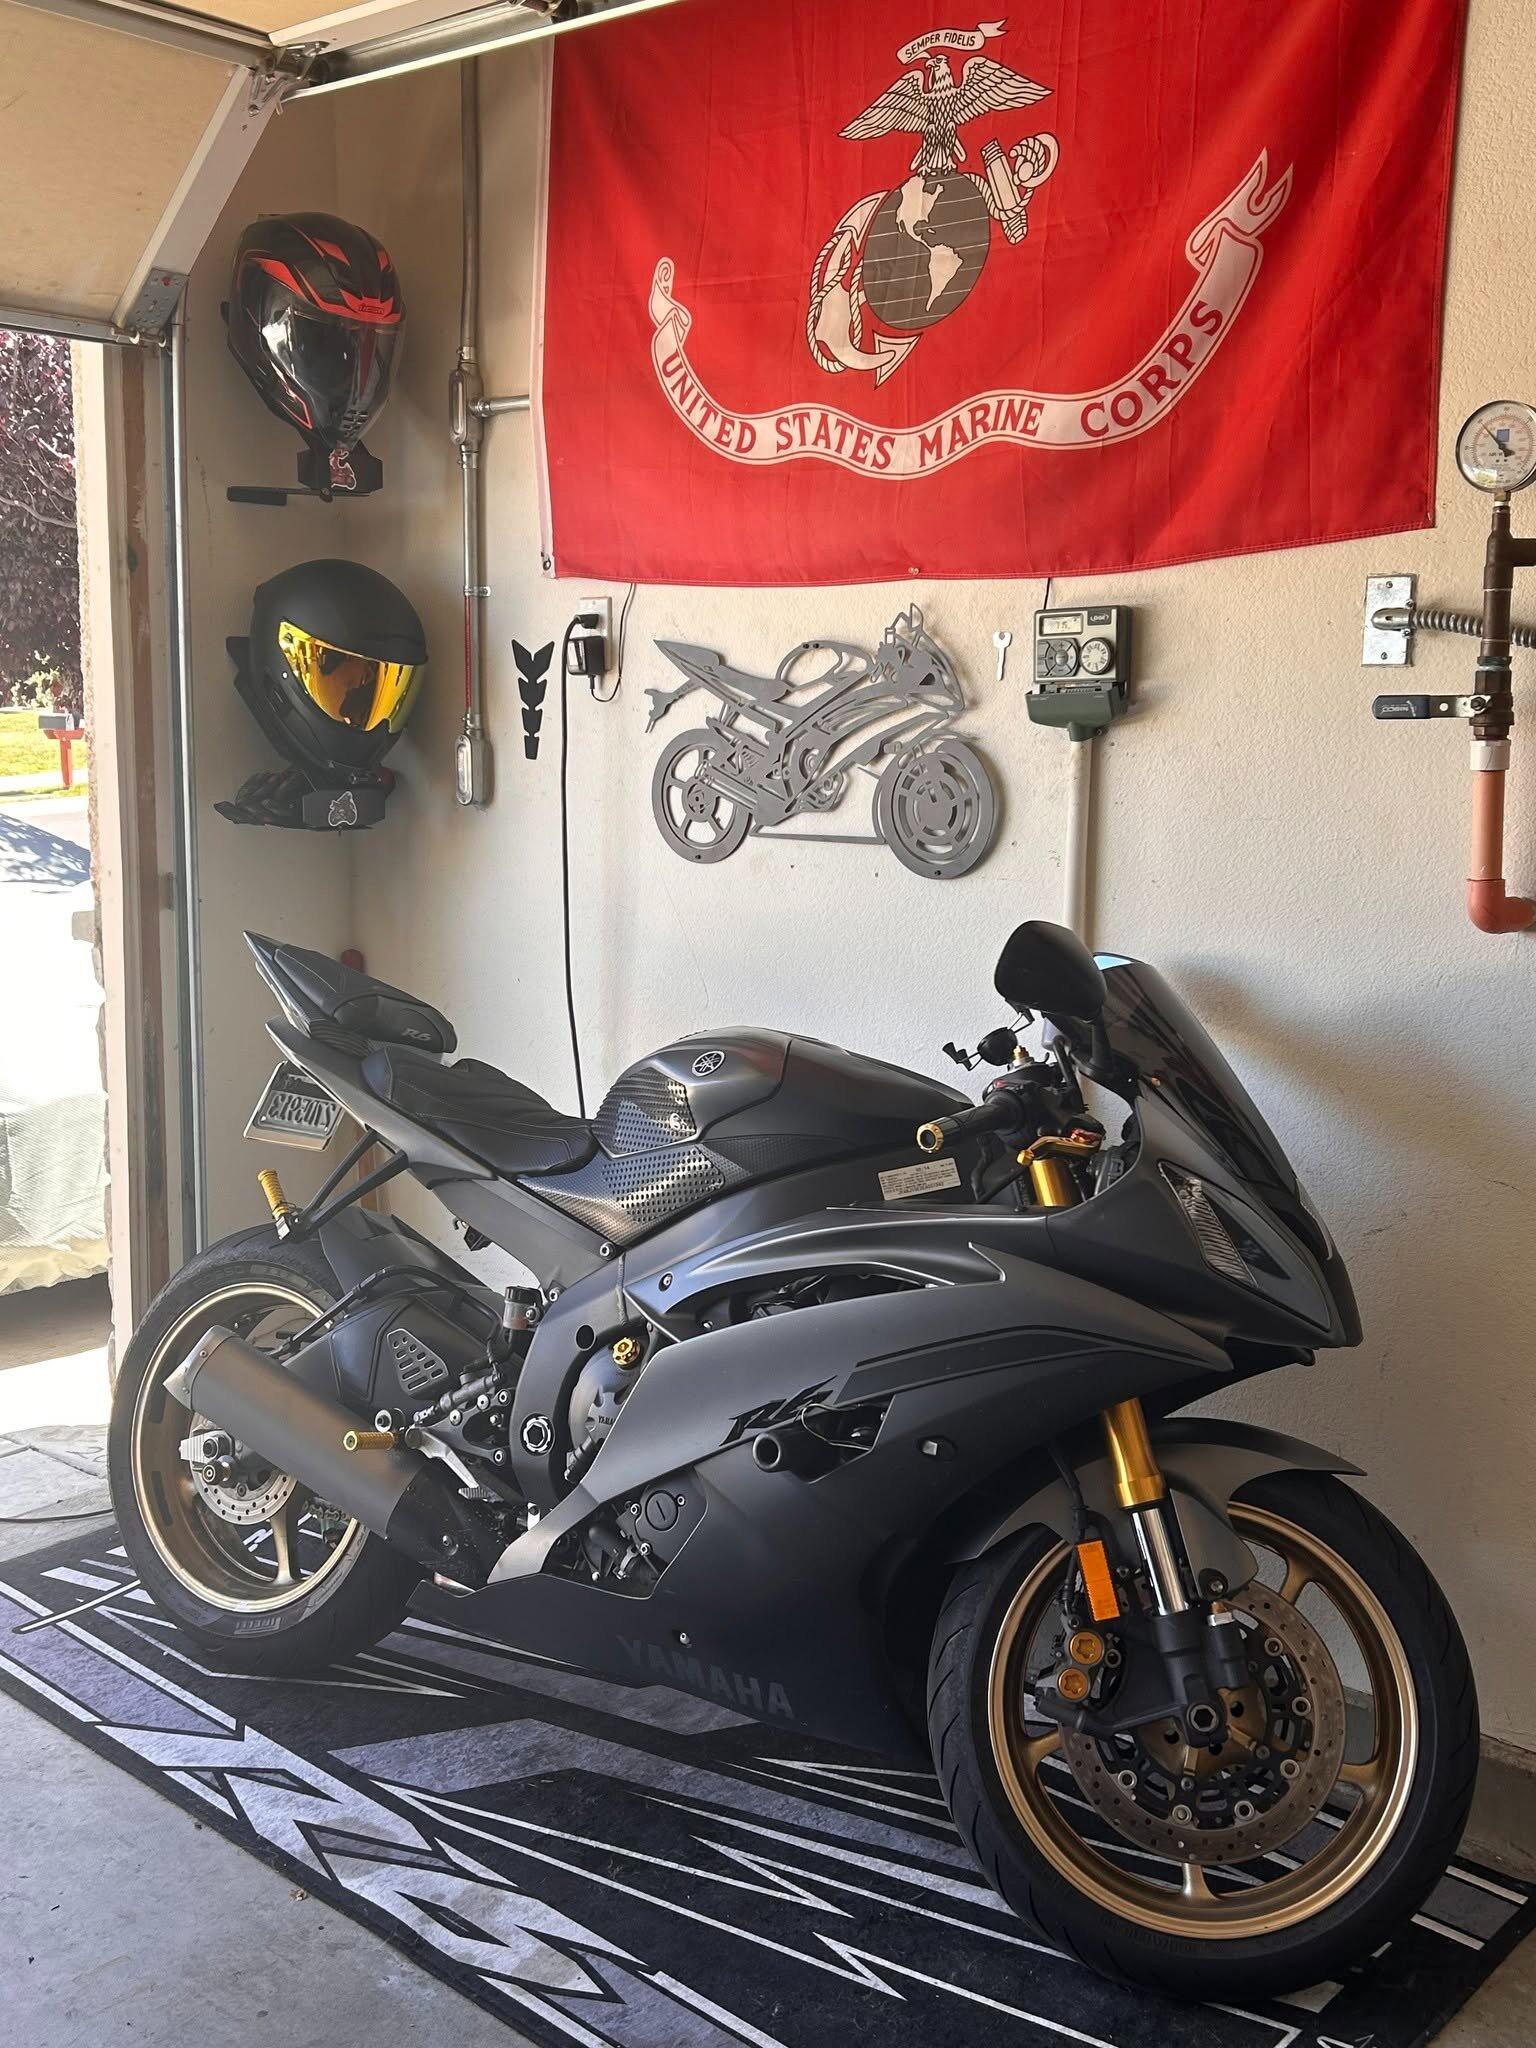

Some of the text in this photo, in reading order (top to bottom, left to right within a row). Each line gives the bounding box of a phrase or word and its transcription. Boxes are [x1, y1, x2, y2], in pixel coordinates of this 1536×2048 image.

[905, 32, 976, 59] SEMPER FIDELIS
[661, 300, 1224, 470] UNITED STATES MARINE CORPS
[402, 1027, 432, 1041] R6
[616, 1634, 796, 1721] YAMAHA
